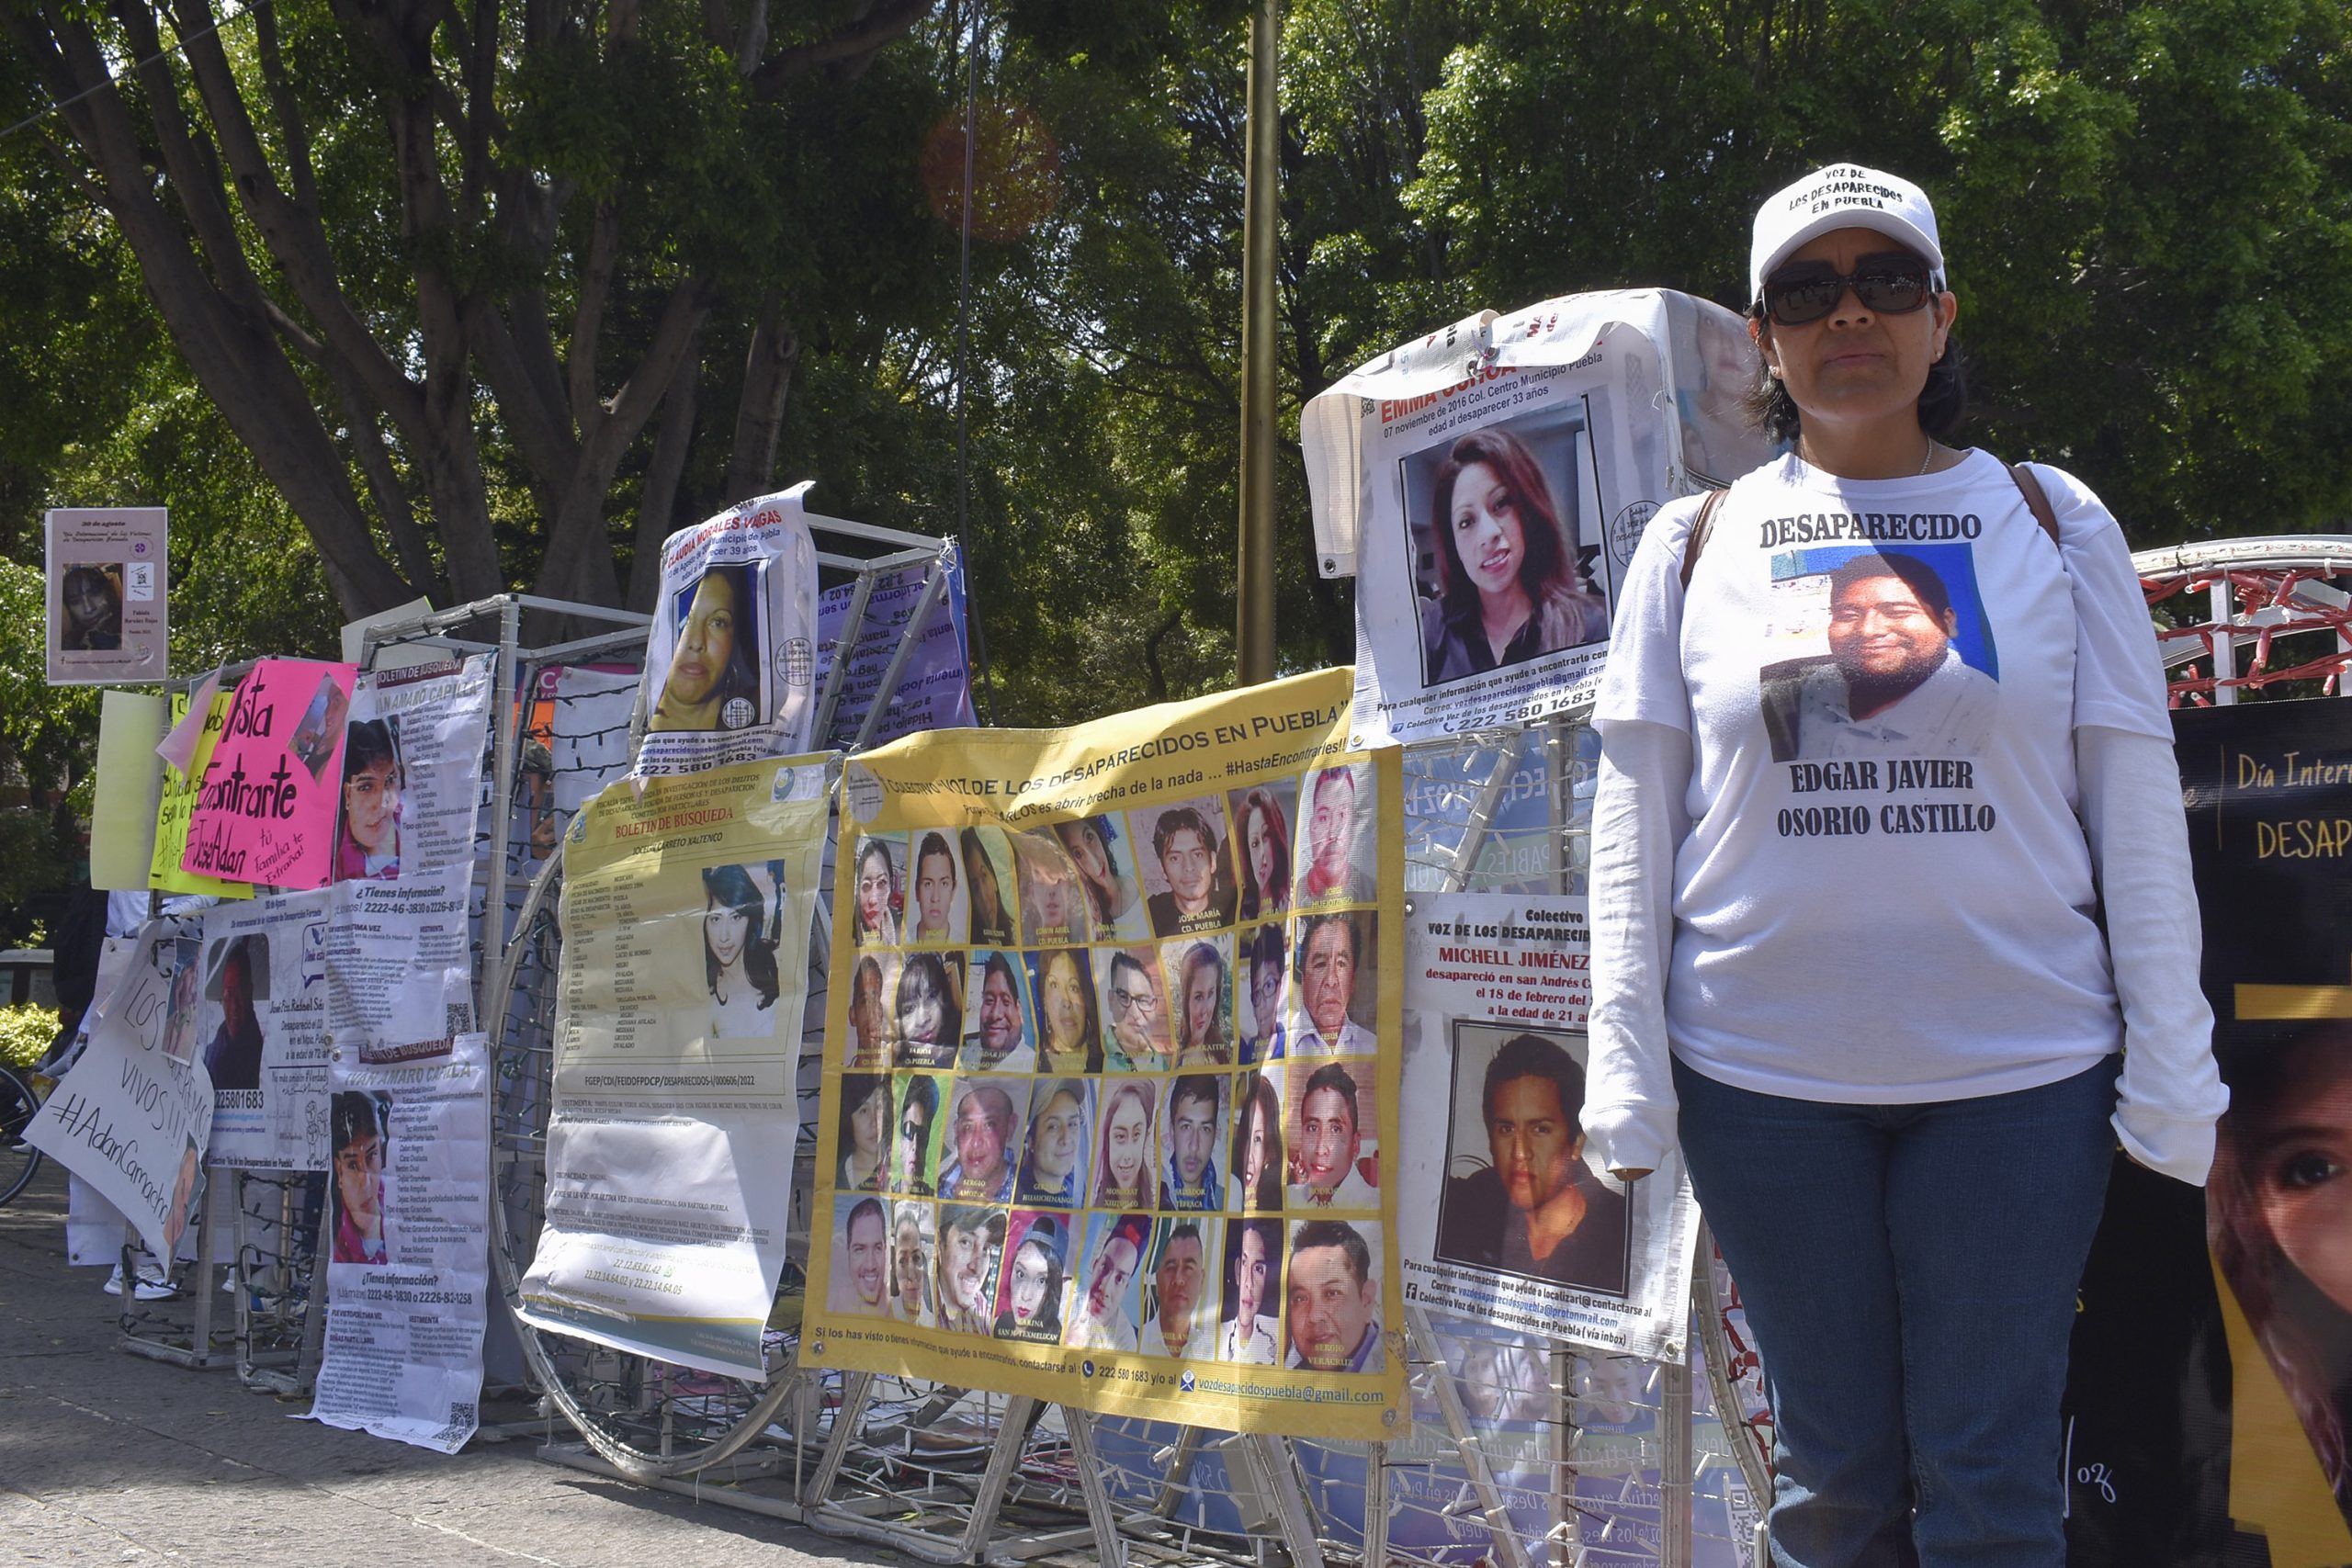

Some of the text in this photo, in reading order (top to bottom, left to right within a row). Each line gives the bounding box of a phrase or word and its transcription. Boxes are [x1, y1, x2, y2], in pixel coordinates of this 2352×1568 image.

[1826, 168, 1866, 179] VOZ DE
[1790, 182, 1903, 210] LOS DESAPARECIDOS
[1813, 197, 1883, 213] EN PUEBLA
[1384, 428, 1393, 438] 07
[1395, 414, 1435, 434] noviembre
[1437, 407, 1446, 417] de
[1447, 398, 1466, 412] 2016
[1468, 390, 1486, 404] Col.
[1487, 379, 1518, 397] Centro
[1521, 363, 1566, 386] Municipio
[1428, 386, 1549, 436] edad al desaparecer 33 años
[1759, 513, 1982, 548] DESAPARECIDO
[729, 546, 740, 555] 39
[1377, 703, 1396, 712] Para
[1399, 694, 1437, 709] cualquier
[1440, 680, 1486, 699] información
[1488, 677, 1503, 688] que
[1505, 669, 1530, 682] ayude
[1539, 654, 1589, 673] encontrarlo
[1407, 680, 1592, 728] Colectivo Voz de los desaparecidos en Puebla
[1424, 703, 1452, 715] Correo:
[1457, 689, 1596, 731] 222 580 1683
[640, 753, 756, 774] 222 580 1683
[973, 781, 999, 795] DE
[1004, 778, 1045, 795] LOS
[1049, 729, 1210, 788] DESAPARECIDOS
[1216, 724, 1248, 746] EN
[2238, 754, 2274, 789] Día
[1790, 760, 1973, 793] EDGAR JAVIER
[1038, 803, 1051, 815] es
[1055, 794, 1084, 810] abrir
[1086, 786, 1126, 807] brecha
[1130, 781, 1147, 795] de
[1151, 777, 1163, 790] la
[1168, 770, 1204, 787] nada
[659, 818, 671, 829] DE
[674, 807, 733, 827] BÚSQUEDA
[1777, 805, 1996, 837] OSORIO CASTILLO
[2257, 819, 2352, 859] DESAP
[1196, 909, 1221, 920] MARÍA
[1526, 908, 1584, 923] Colectivo
[1182, 920, 1222, 934] CD. PUEBLA
[1428, 922, 1451, 936] VOZ
[1454, 925, 1471, 937] DE
[1475, 925, 1498, 938] LOS
[1439, 946, 1590, 970] MICHELL JIMÉNEZ
[1426, 968, 1578, 988] desapareció en san Andrés
[1476, 987, 1586, 1006] el 18 de febrero del
[124, 977, 166, 1053] LOS
[1487, 1005, 1572, 1021] a la edad de 21
[1404, 1258, 1421, 1271] Para
[1423, 1264, 1458, 1280] cualquier
[1458, 1271, 1500, 1289] información
[1501, 1280, 1514, 1292] que
[1515, 1282, 1536, 1297] ayude
[1544, 1288, 1591, 1309] localizarl@
[1592, 1300, 1643, 1315] contactarse
[1645, 1307, 1652, 1318] al
[1431, 1280, 1457, 1293] Correo:
[1419, 1292, 1453, 1308] Colectivo
[1454, 1301, 1465, 1311] Voz
[1467, 1303, 1476, 1313] de
[1476, 1305, 1487, 1316] los
[1488, 1308, 1539, 1328] desaparecidos
[1541, 1319, 1551, 1329] en
[1552, 1320, 1580, 1337] Puebla
[1600, 1330, 1626, 1347] inbox)
[816, 1327, 826, 1339] Si
[829, 1328, 842, 1339] los
[846, 1329, 862, 1339] has
[865, 1332, 884, 1342] visto
[938, 1347, 949, 1356] que
[950, 1348, 970, 1359] ayude
[973, 1350, 978, 1359] a
[1019, 1359, 1066, 1373] contactarse
[1314, 1343, 1345, 1352] SERGIO
[1307, 1358, 1354, 1367] VERACRUZ
[1099, 1366, 1176, 1386] 222 580 1683 y/o al
